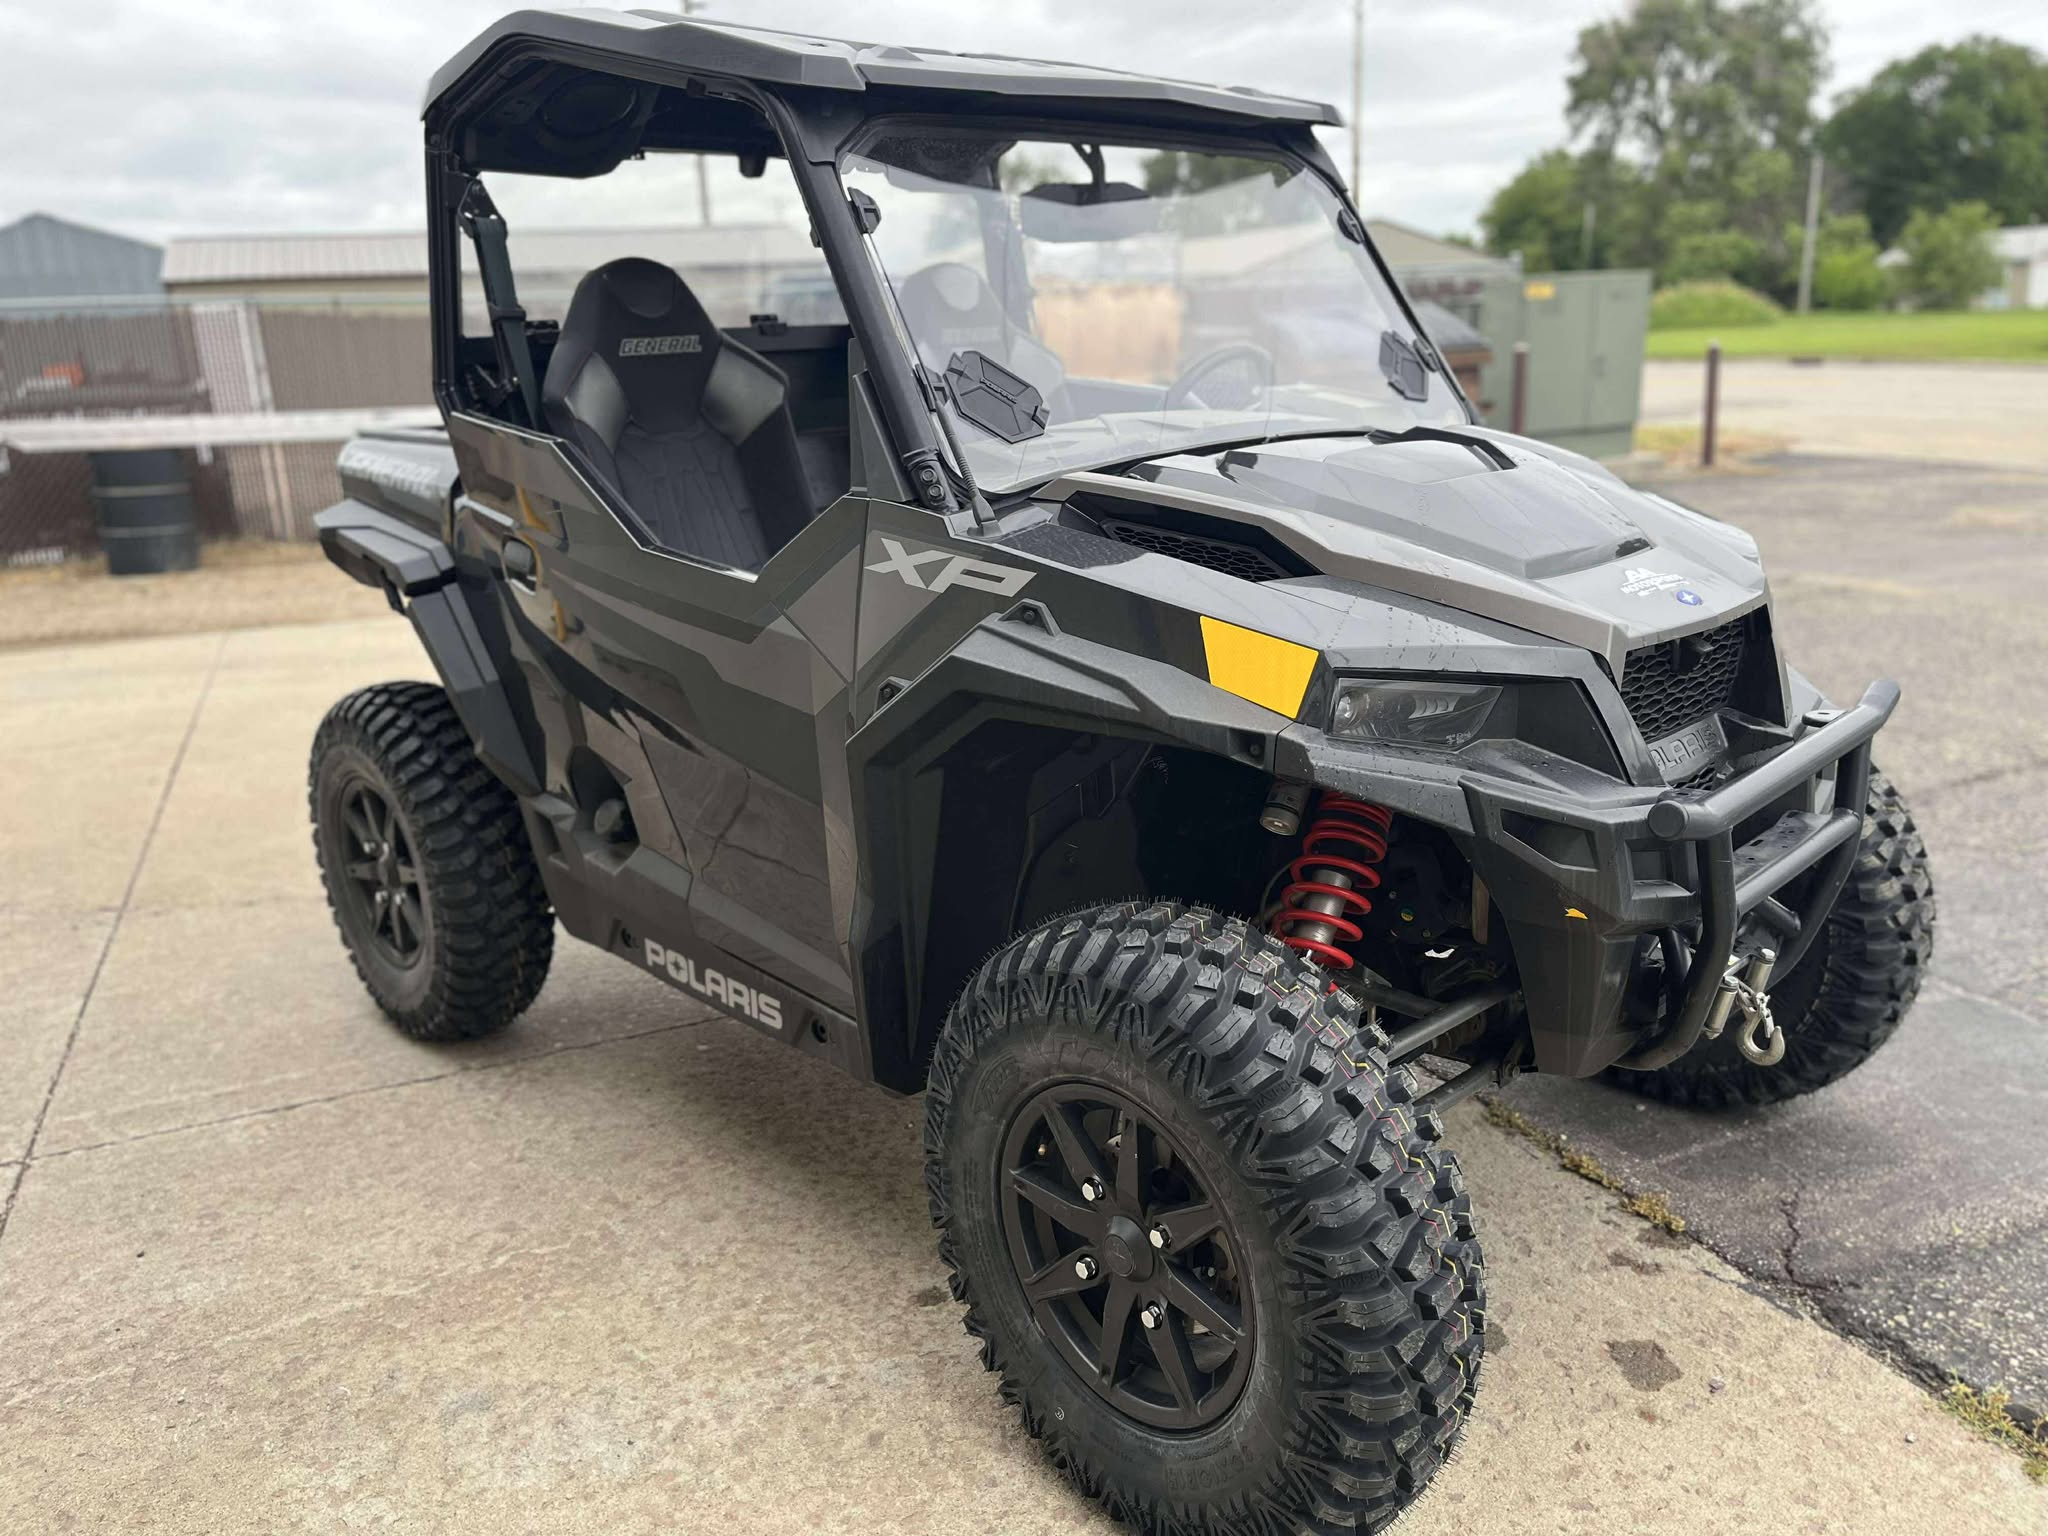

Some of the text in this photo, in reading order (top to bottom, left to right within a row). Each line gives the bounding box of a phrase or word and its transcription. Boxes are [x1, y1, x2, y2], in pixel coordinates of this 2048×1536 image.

[619, 335, 702, 356] GENERAL
[864, 538, 1038, 598] XP
[1649, 722, 1718, 771] OLARIS
[644, 938, 784, 1030] POLARIS
